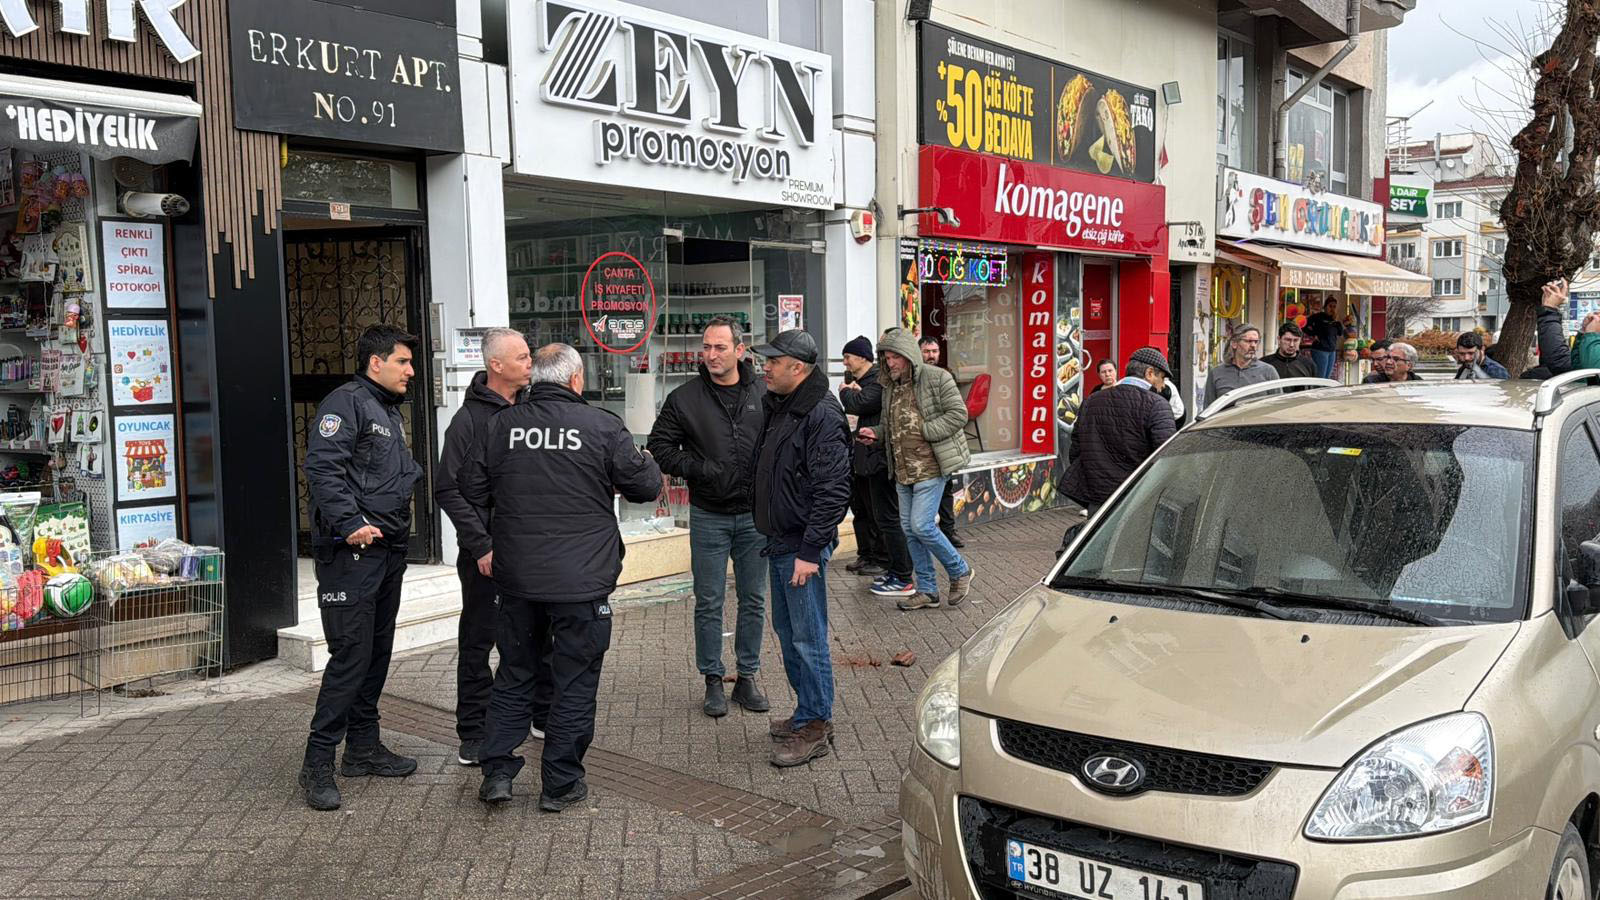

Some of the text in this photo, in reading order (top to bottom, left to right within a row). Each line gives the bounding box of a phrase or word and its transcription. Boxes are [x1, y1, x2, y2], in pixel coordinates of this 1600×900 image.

[248, 29, 382, 80] ERKURT
[391, 54, 451, 92] APT.
[538, 1, 823, 147] ZEYN
[984, 70, 1034, 117] ÇİĞ KÖFTE
[1130, 104, 1153, 132] TAKO
[17, 106, 158, 151] HEDİYELİK
[984, 110, 1034, 161] BEDAVA
[598, 121, 790, 181] promosyon
[789, 180, 824, 193] PREMIUM
[781, 191, 832, 206] SHOWROOM
[994, 163, 1124, 237] komagene
[1249, 187, 1370, 243] ŞEN OYUNCAK
[115, 228, 153, 240] RENKLİ
[1082, 228, 1098, 241] etsiz
[121, 247, 148, 258] ÇIKTI
[117, 263, 154, 275] SPİRAL
[604, 267, 635, 279] ÇANTA
[110, 282, 161, 292] FOTOKOPİ
[594, 281, 645, 296] İŞ KIYAFETİ
[591, 301, 649, 311] PROMOSYON
[112, 325, 166, 336] HEDİYELİK
[608, 318, 645, 330] aras
[1028, 261, 1050, 444] komagene
[118, 420, 171, 432] OYUNCAK
[120, 511, 173, 525] KIRTASİYE
[1012, 861, 1024, 872] TR
[1028, 848, 1060, 885] 38
[1079, 861, 1114, 900] UZ
